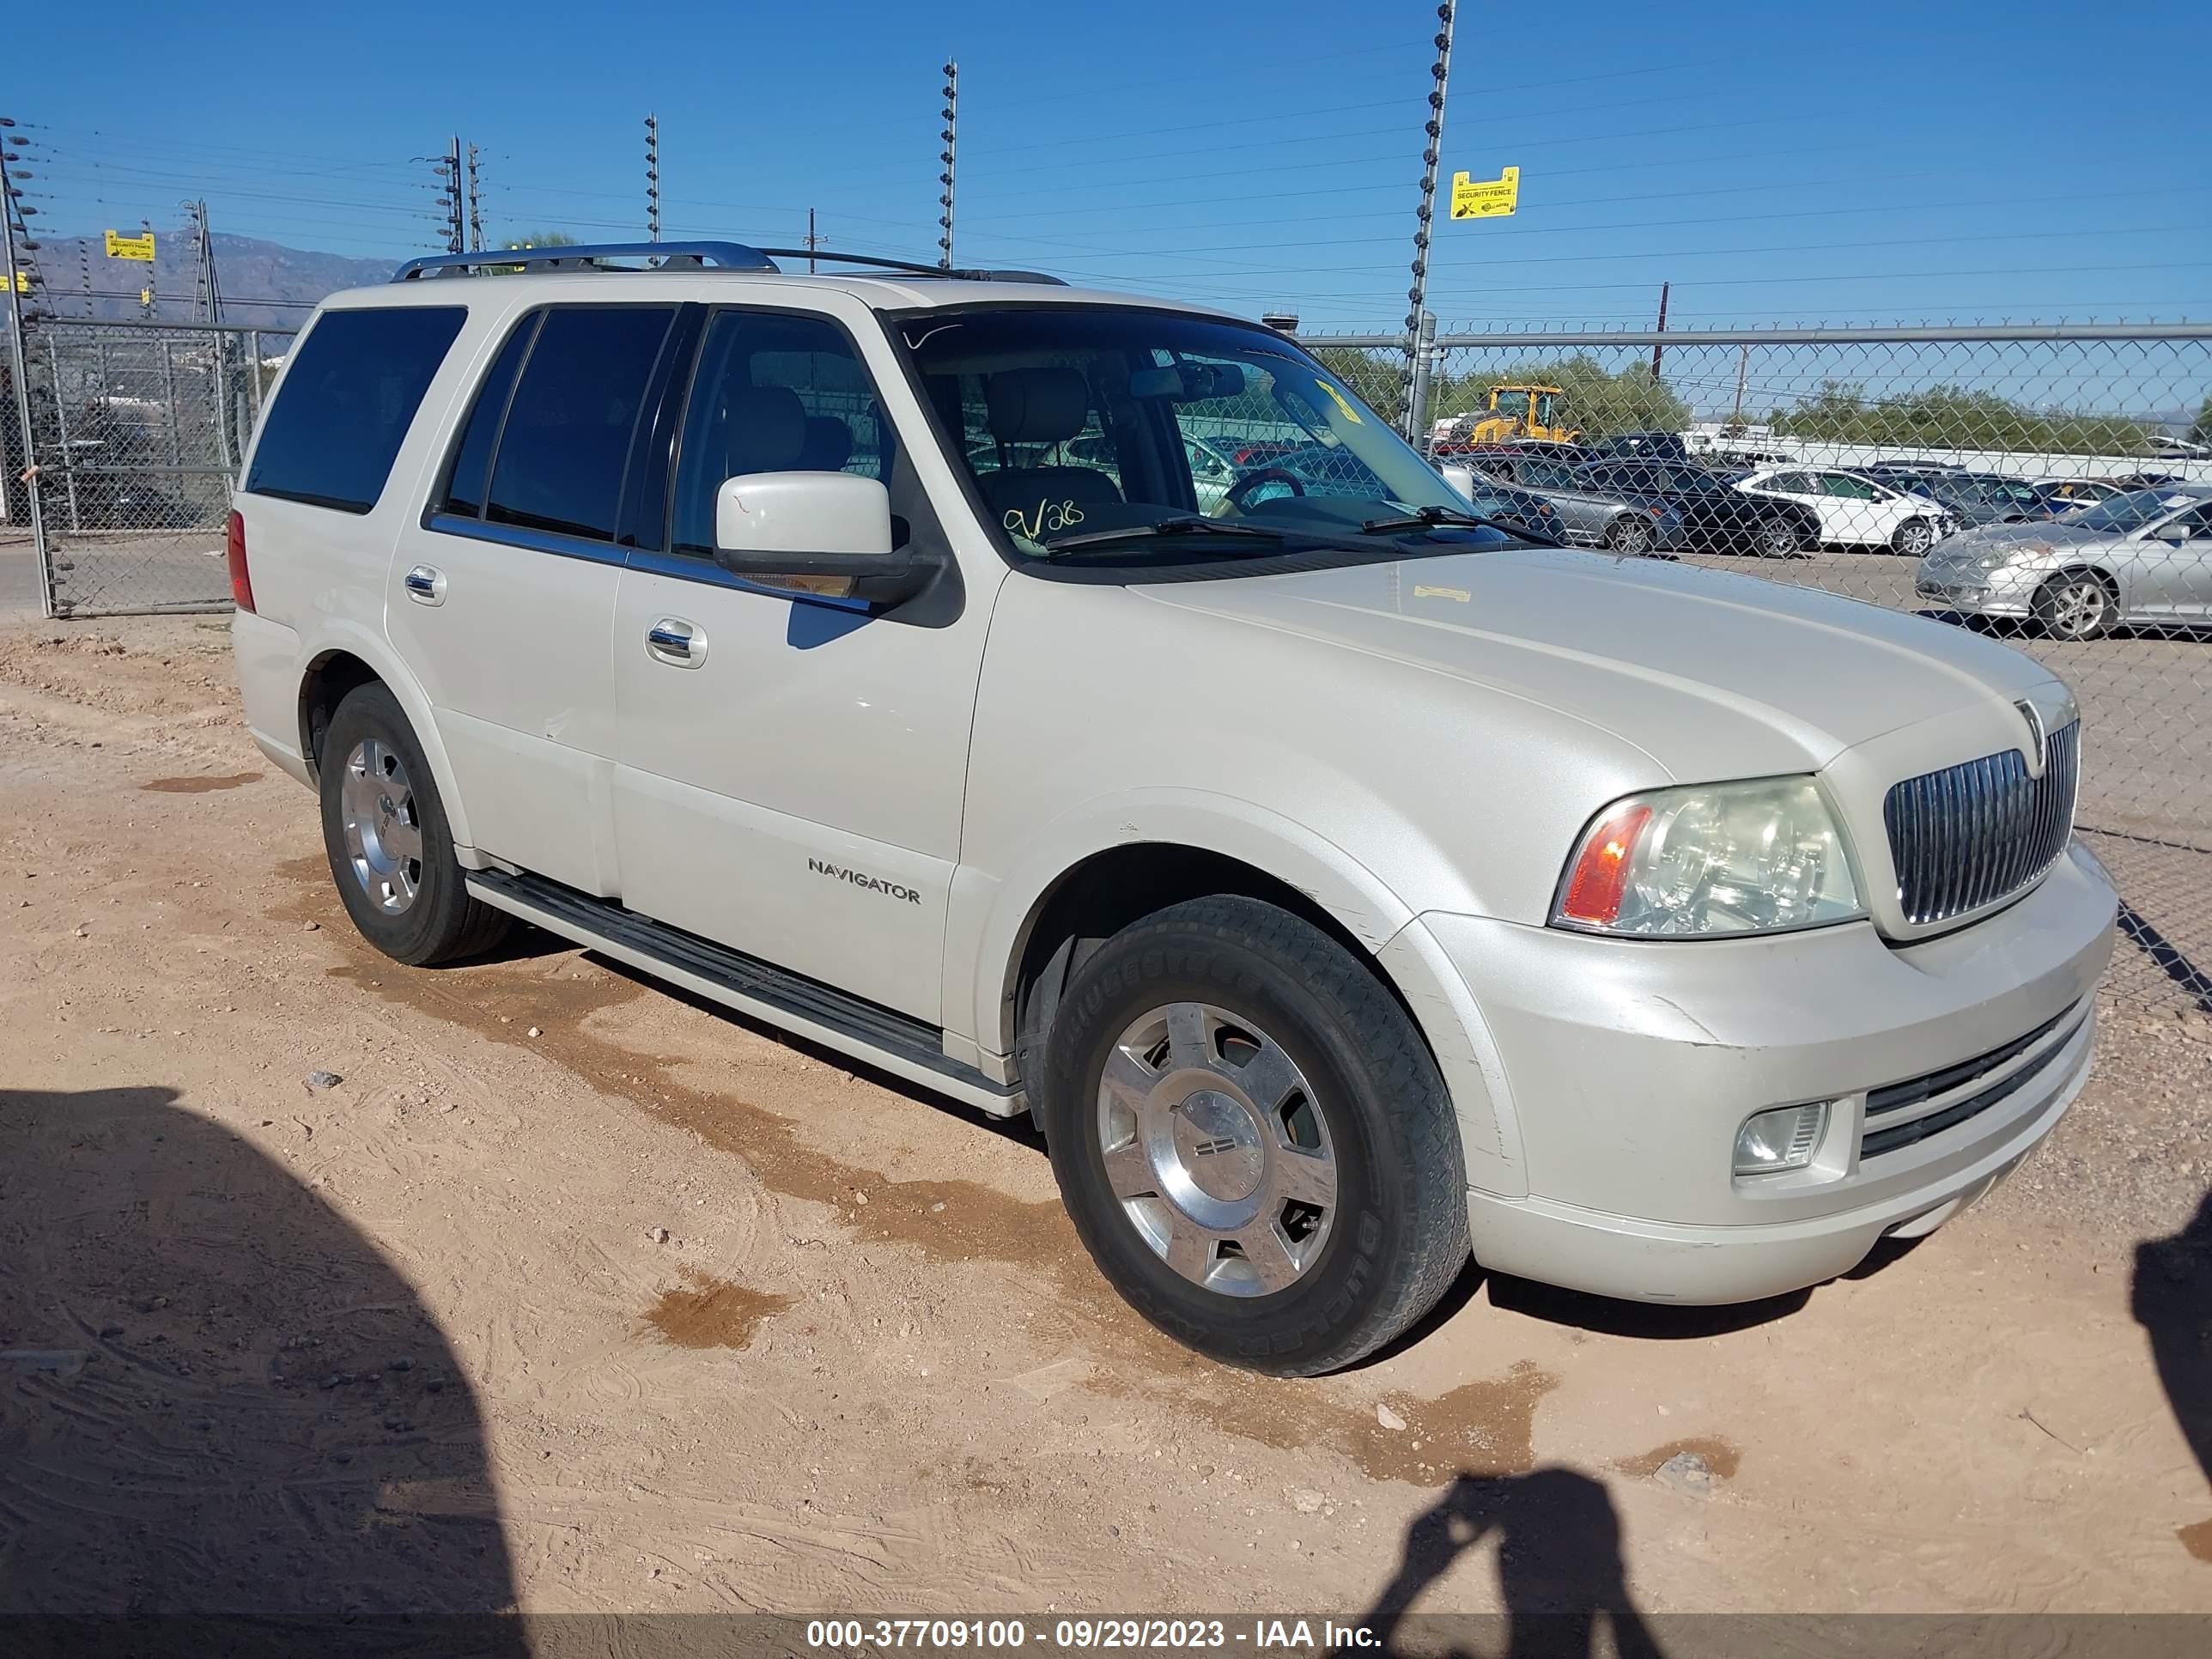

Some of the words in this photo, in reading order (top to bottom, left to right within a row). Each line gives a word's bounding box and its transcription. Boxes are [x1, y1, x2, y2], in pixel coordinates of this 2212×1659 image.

[1457, 191, 1489, 199] SECURITY
[1490, 188, 1512, 197] FENCE
[807, 857, 922, 905] NAVIGATOR
